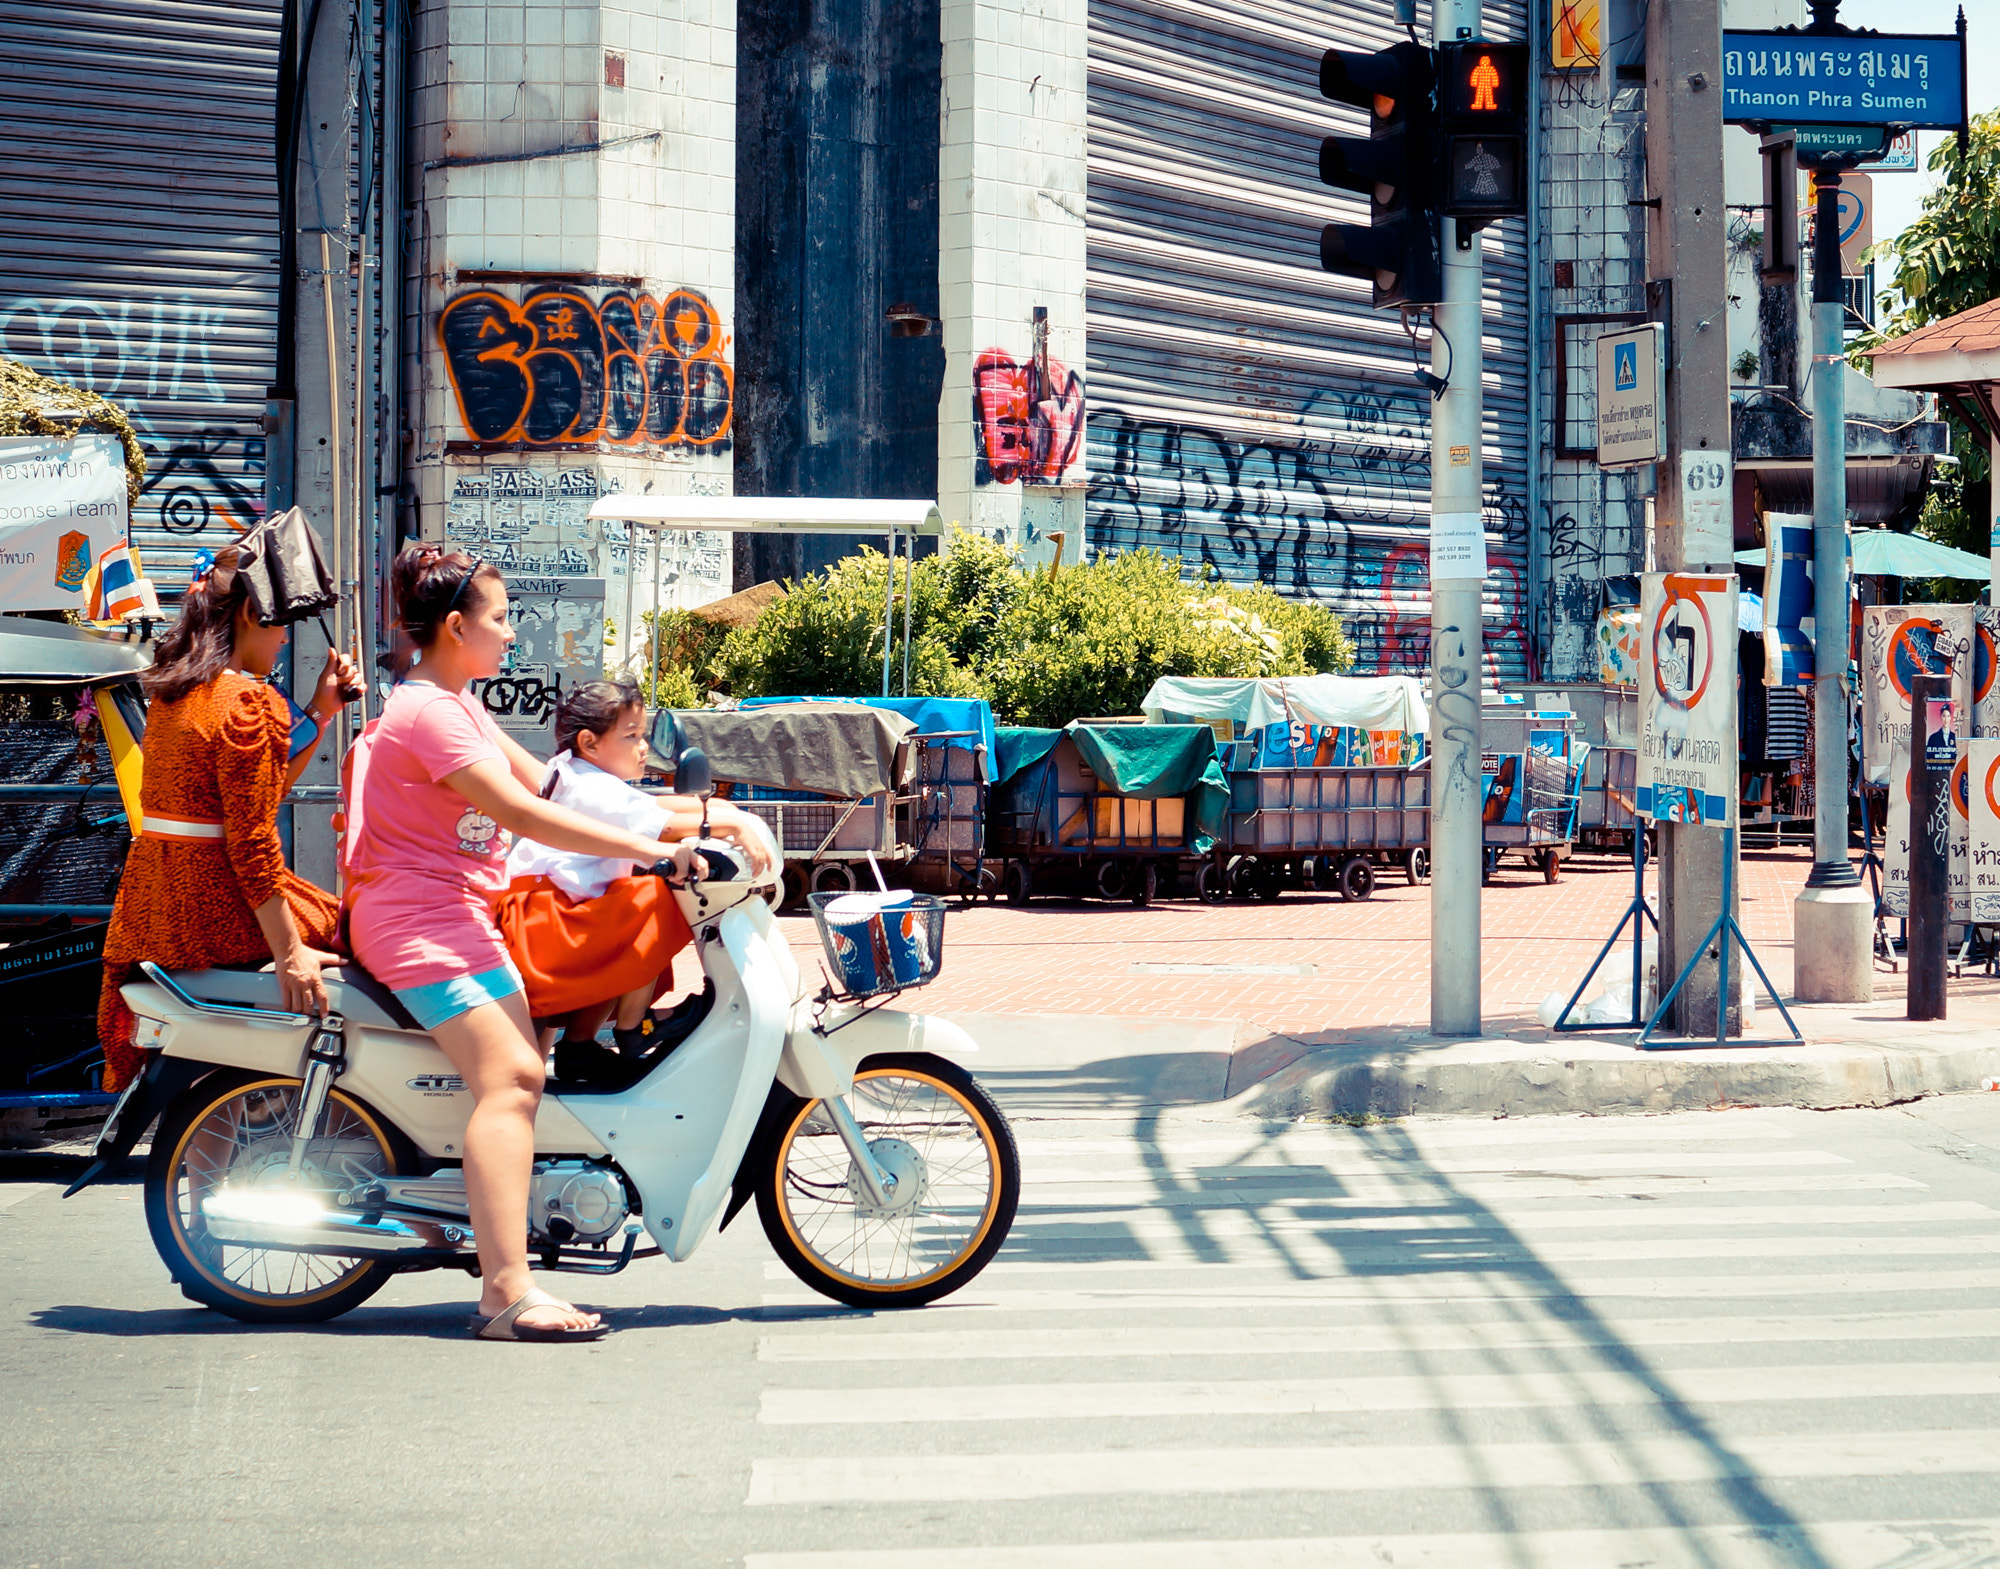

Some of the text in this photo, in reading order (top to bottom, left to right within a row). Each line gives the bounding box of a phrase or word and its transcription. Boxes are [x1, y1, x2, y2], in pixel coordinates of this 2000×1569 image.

[1725, 50, 1929, 90] ถนนพระสุเมรุ
[1727, 88, 1927, 109] Thanon Phra Sumen
[1795, 132, 1862, 145] ขตพระนคร
[1687, 463, 1725, 491] 69
[64, 499, 117, 517] Team
